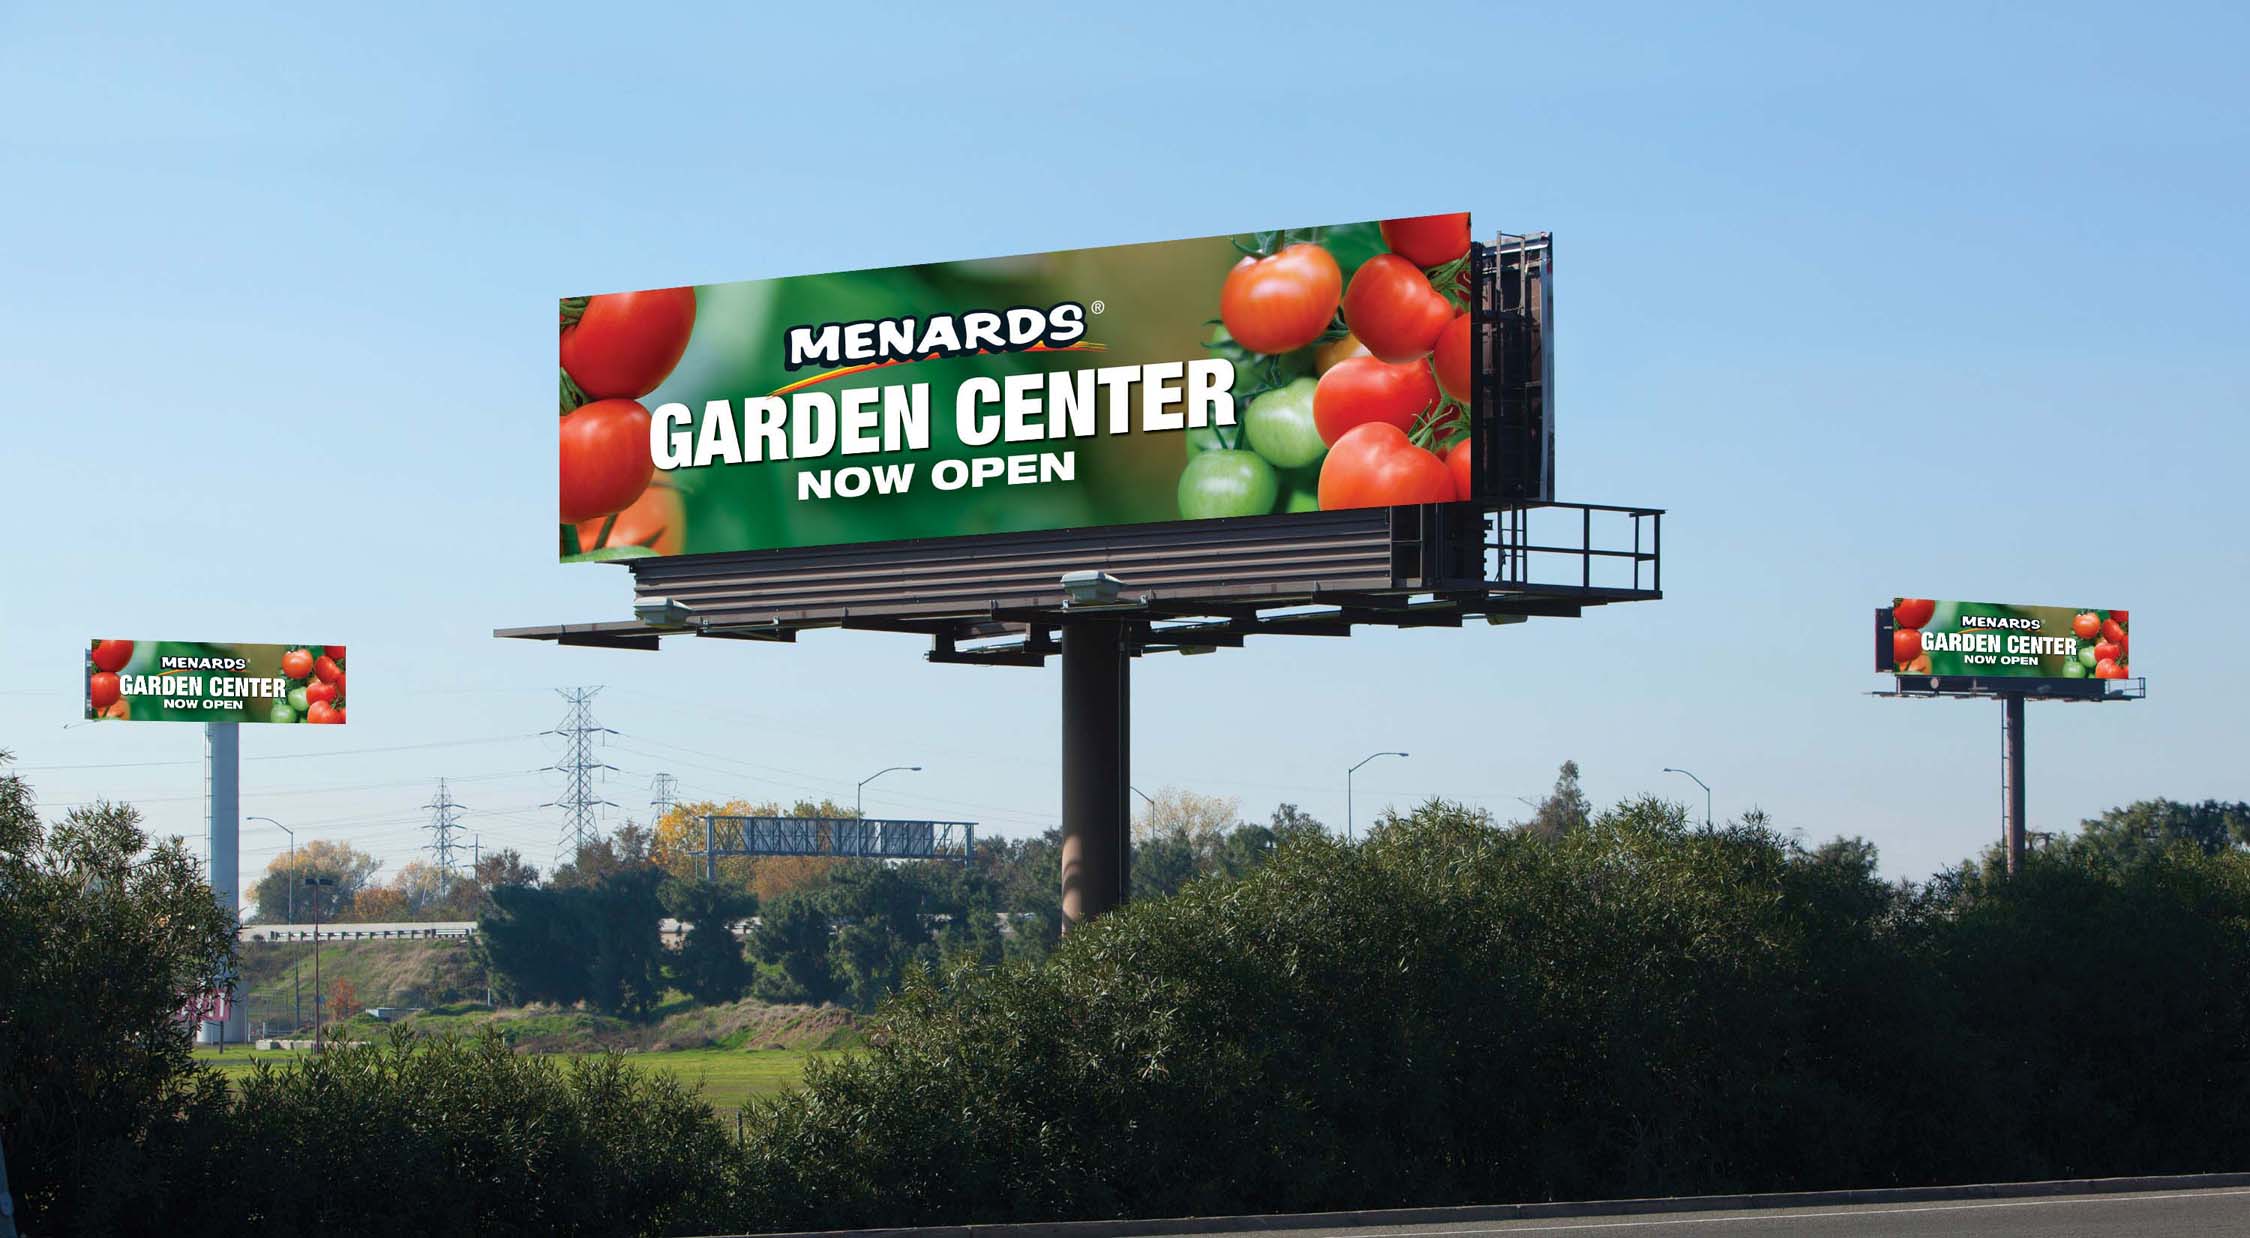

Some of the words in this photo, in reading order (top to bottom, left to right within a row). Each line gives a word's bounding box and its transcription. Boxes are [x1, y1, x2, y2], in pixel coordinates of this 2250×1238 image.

[649, 382, 930, 470] GARDEN
[956, 358, 1238, 446] CENTER
[798, 463, 916, 501] NOW
[931, 451, 1075, 491] OPEN
[1961, 615, 2041, 630] MENARDS
[1920, 631, 2001, 653] GARDEN
[2007, 635, 2077, 656] CENTER
[160, 656, 246, 670] MENARDS
[1963, 654, 1997, 665] NOW
[2000, 655, 2039, 666] OPEN
[119, 673, 203, 697] GARDEN
[209, 675, 286, 698] CENTER
[163, 699, 199, 709] NOW
[202, 699, 243, 710] OPEN
